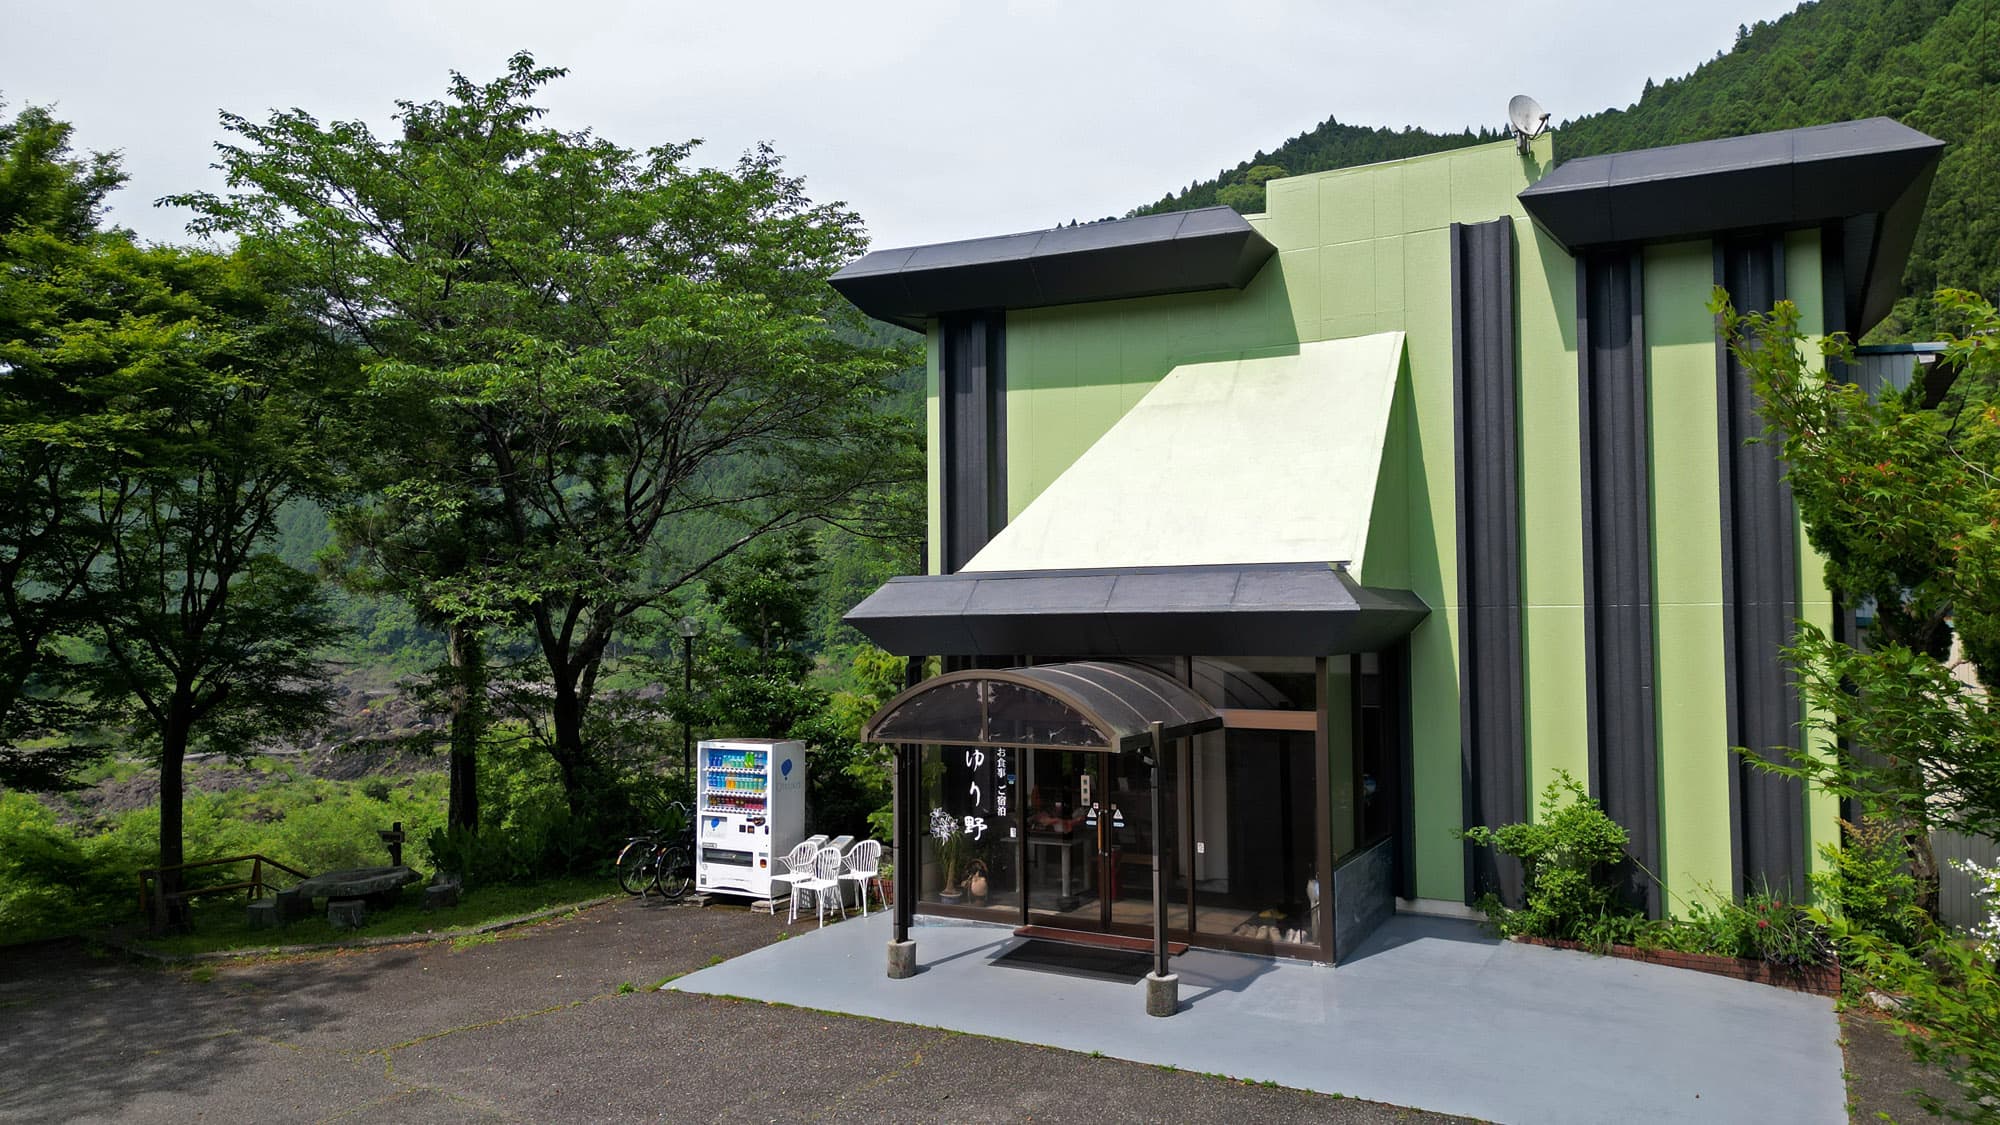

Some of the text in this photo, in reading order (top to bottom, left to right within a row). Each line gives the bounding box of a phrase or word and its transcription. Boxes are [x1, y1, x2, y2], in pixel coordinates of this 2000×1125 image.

[964, 749, 988, 841] ゆり野
[997, 747, 1007, 817] お食事 ご宿泊
